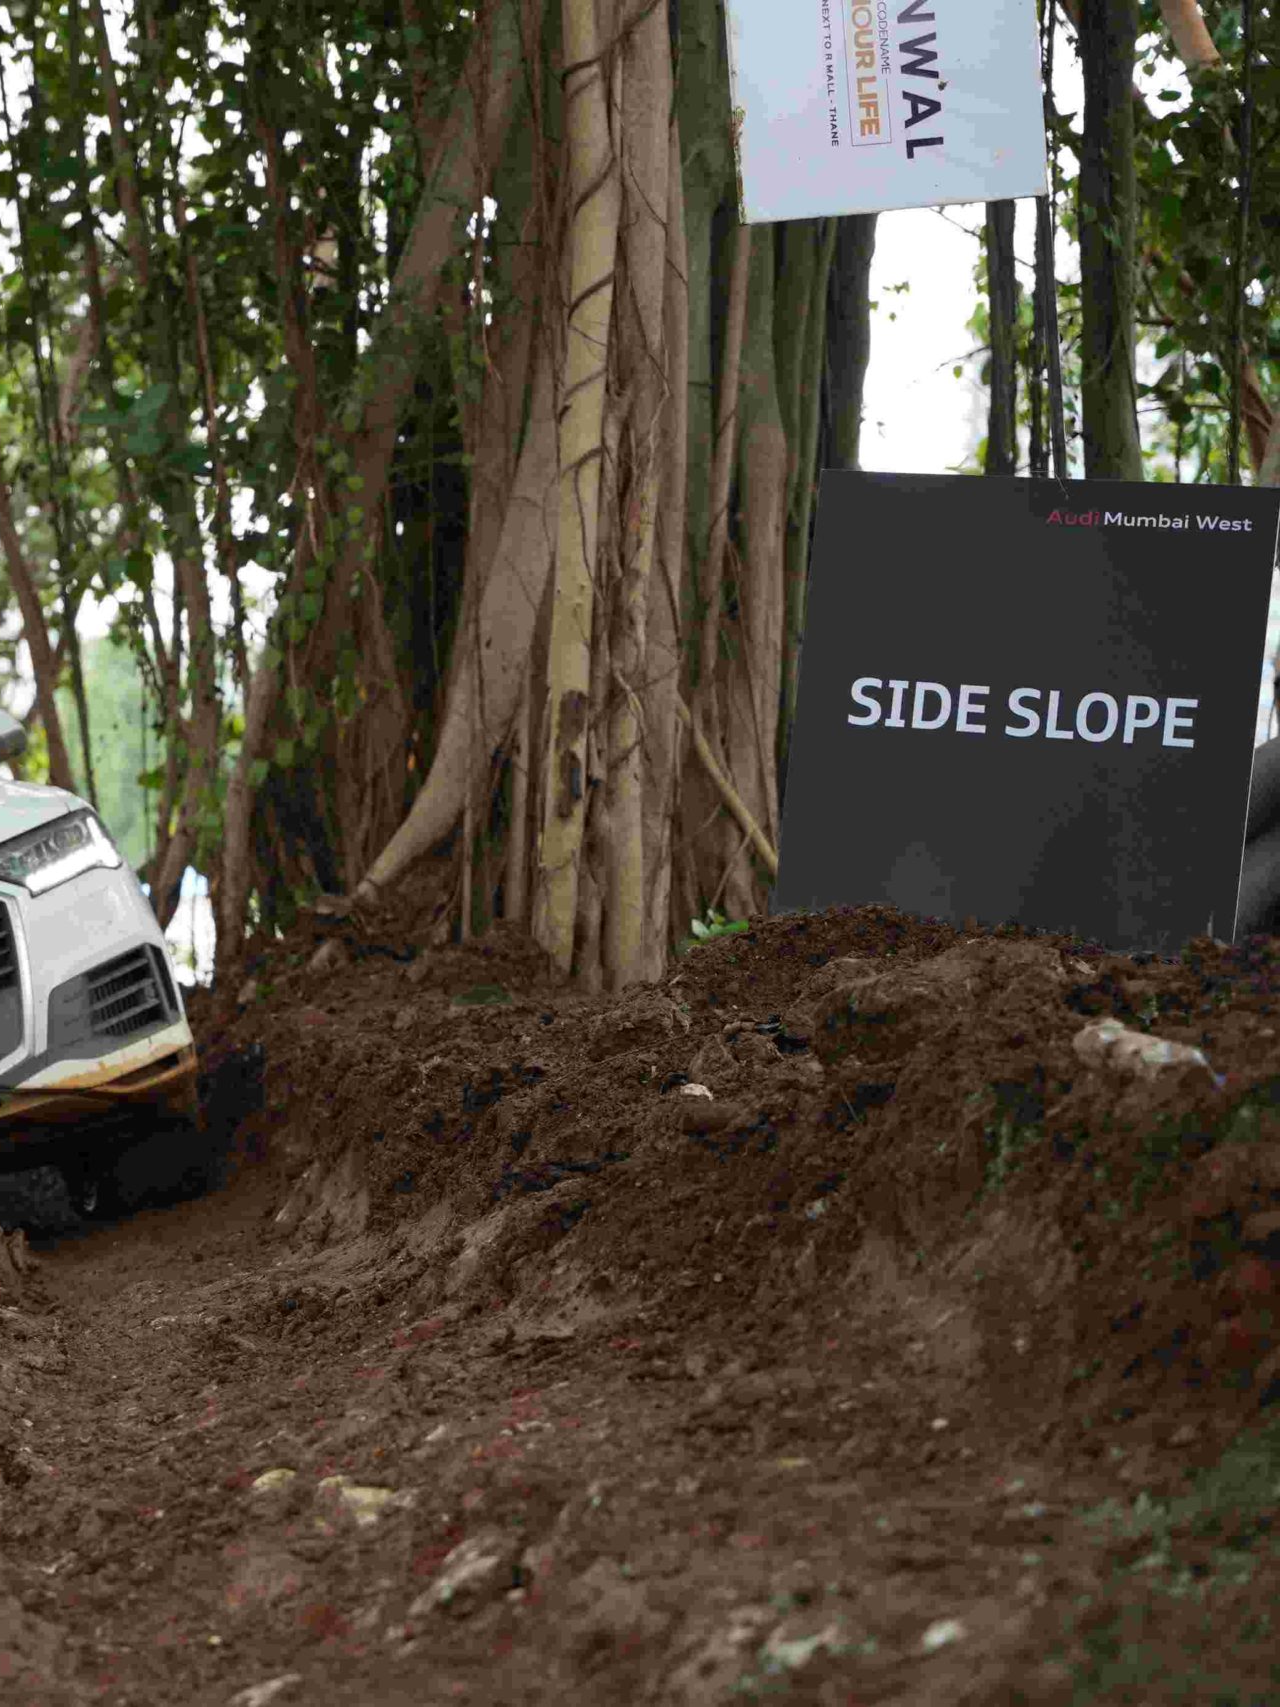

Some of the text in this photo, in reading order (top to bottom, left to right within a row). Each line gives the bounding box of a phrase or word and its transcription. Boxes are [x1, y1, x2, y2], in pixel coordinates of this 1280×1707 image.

[821, 0, 831, 30] NEXT
[824, 34, 832, 49] TO
[877, 2, 891, 75] CODENAME
[825, 53, 832, 61] R
[826, 64, 835, 97] MALL
[857, 76, 880, 136] LIFE
[829, 107, 839, 147] THANE
[1046, 511, 1253, 532] Audi Mumbai West
[847, 676, 1199, 748] SIDE SLOPE
